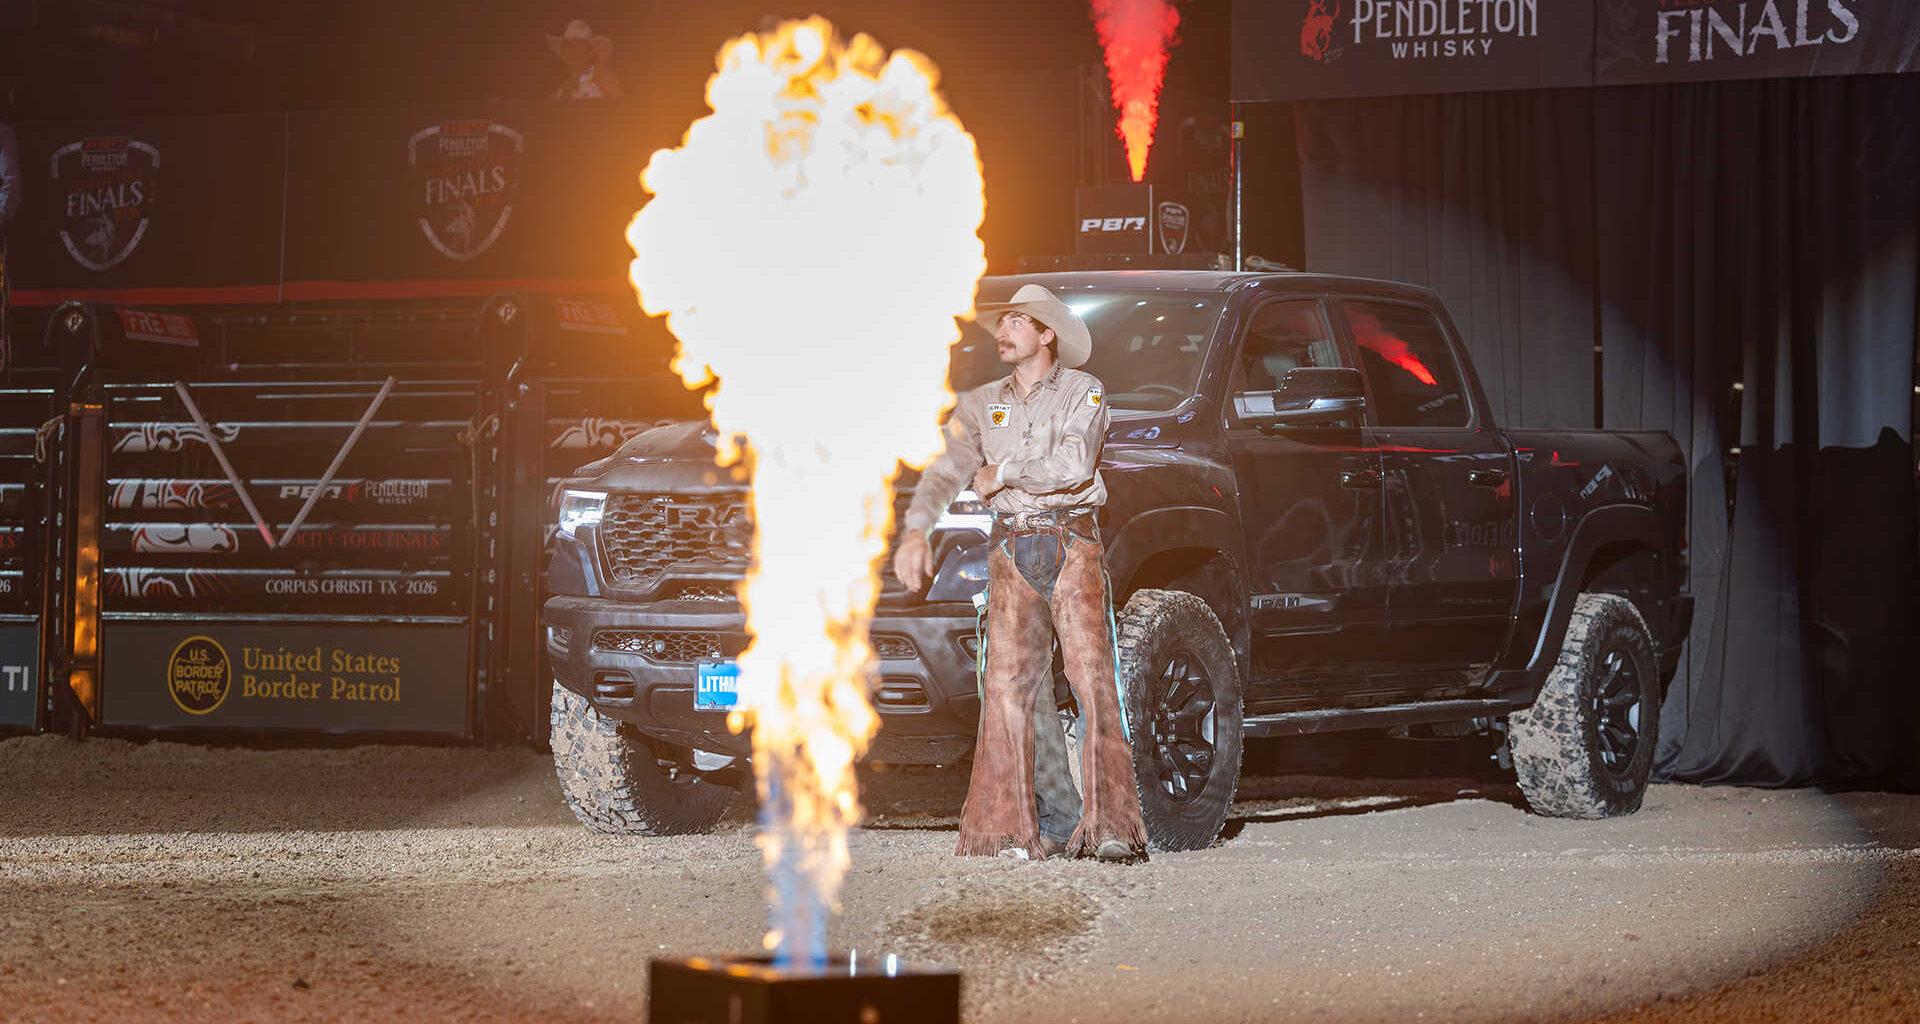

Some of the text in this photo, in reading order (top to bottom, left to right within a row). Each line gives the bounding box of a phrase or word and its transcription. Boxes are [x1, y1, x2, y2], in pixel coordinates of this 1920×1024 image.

[1350, 0, 1538, 43] PENDLETON
[1655, 0, 1860, 63] FINALS
[1391, 39, 1493, 59] WHISKY
[425, 166, 505, 204] FINALS
[67, 180, 144, 217] FINALS
[1080, 217, 1146, 232] PBR
[365, 481, 428, 498] PENDLETON
[343, 532, 382, 549] TOUR
[386, 532, 440, 549] FINALS
[265, 579, 437, 594] CORPUS CHRISTI TX 2026
[242, 648, 400, 674] United States
[176, 665, 223, 678] BORDER
[176, 680, 220, 694] PATROL
[241, 675, 400, 701] Border Patrol
